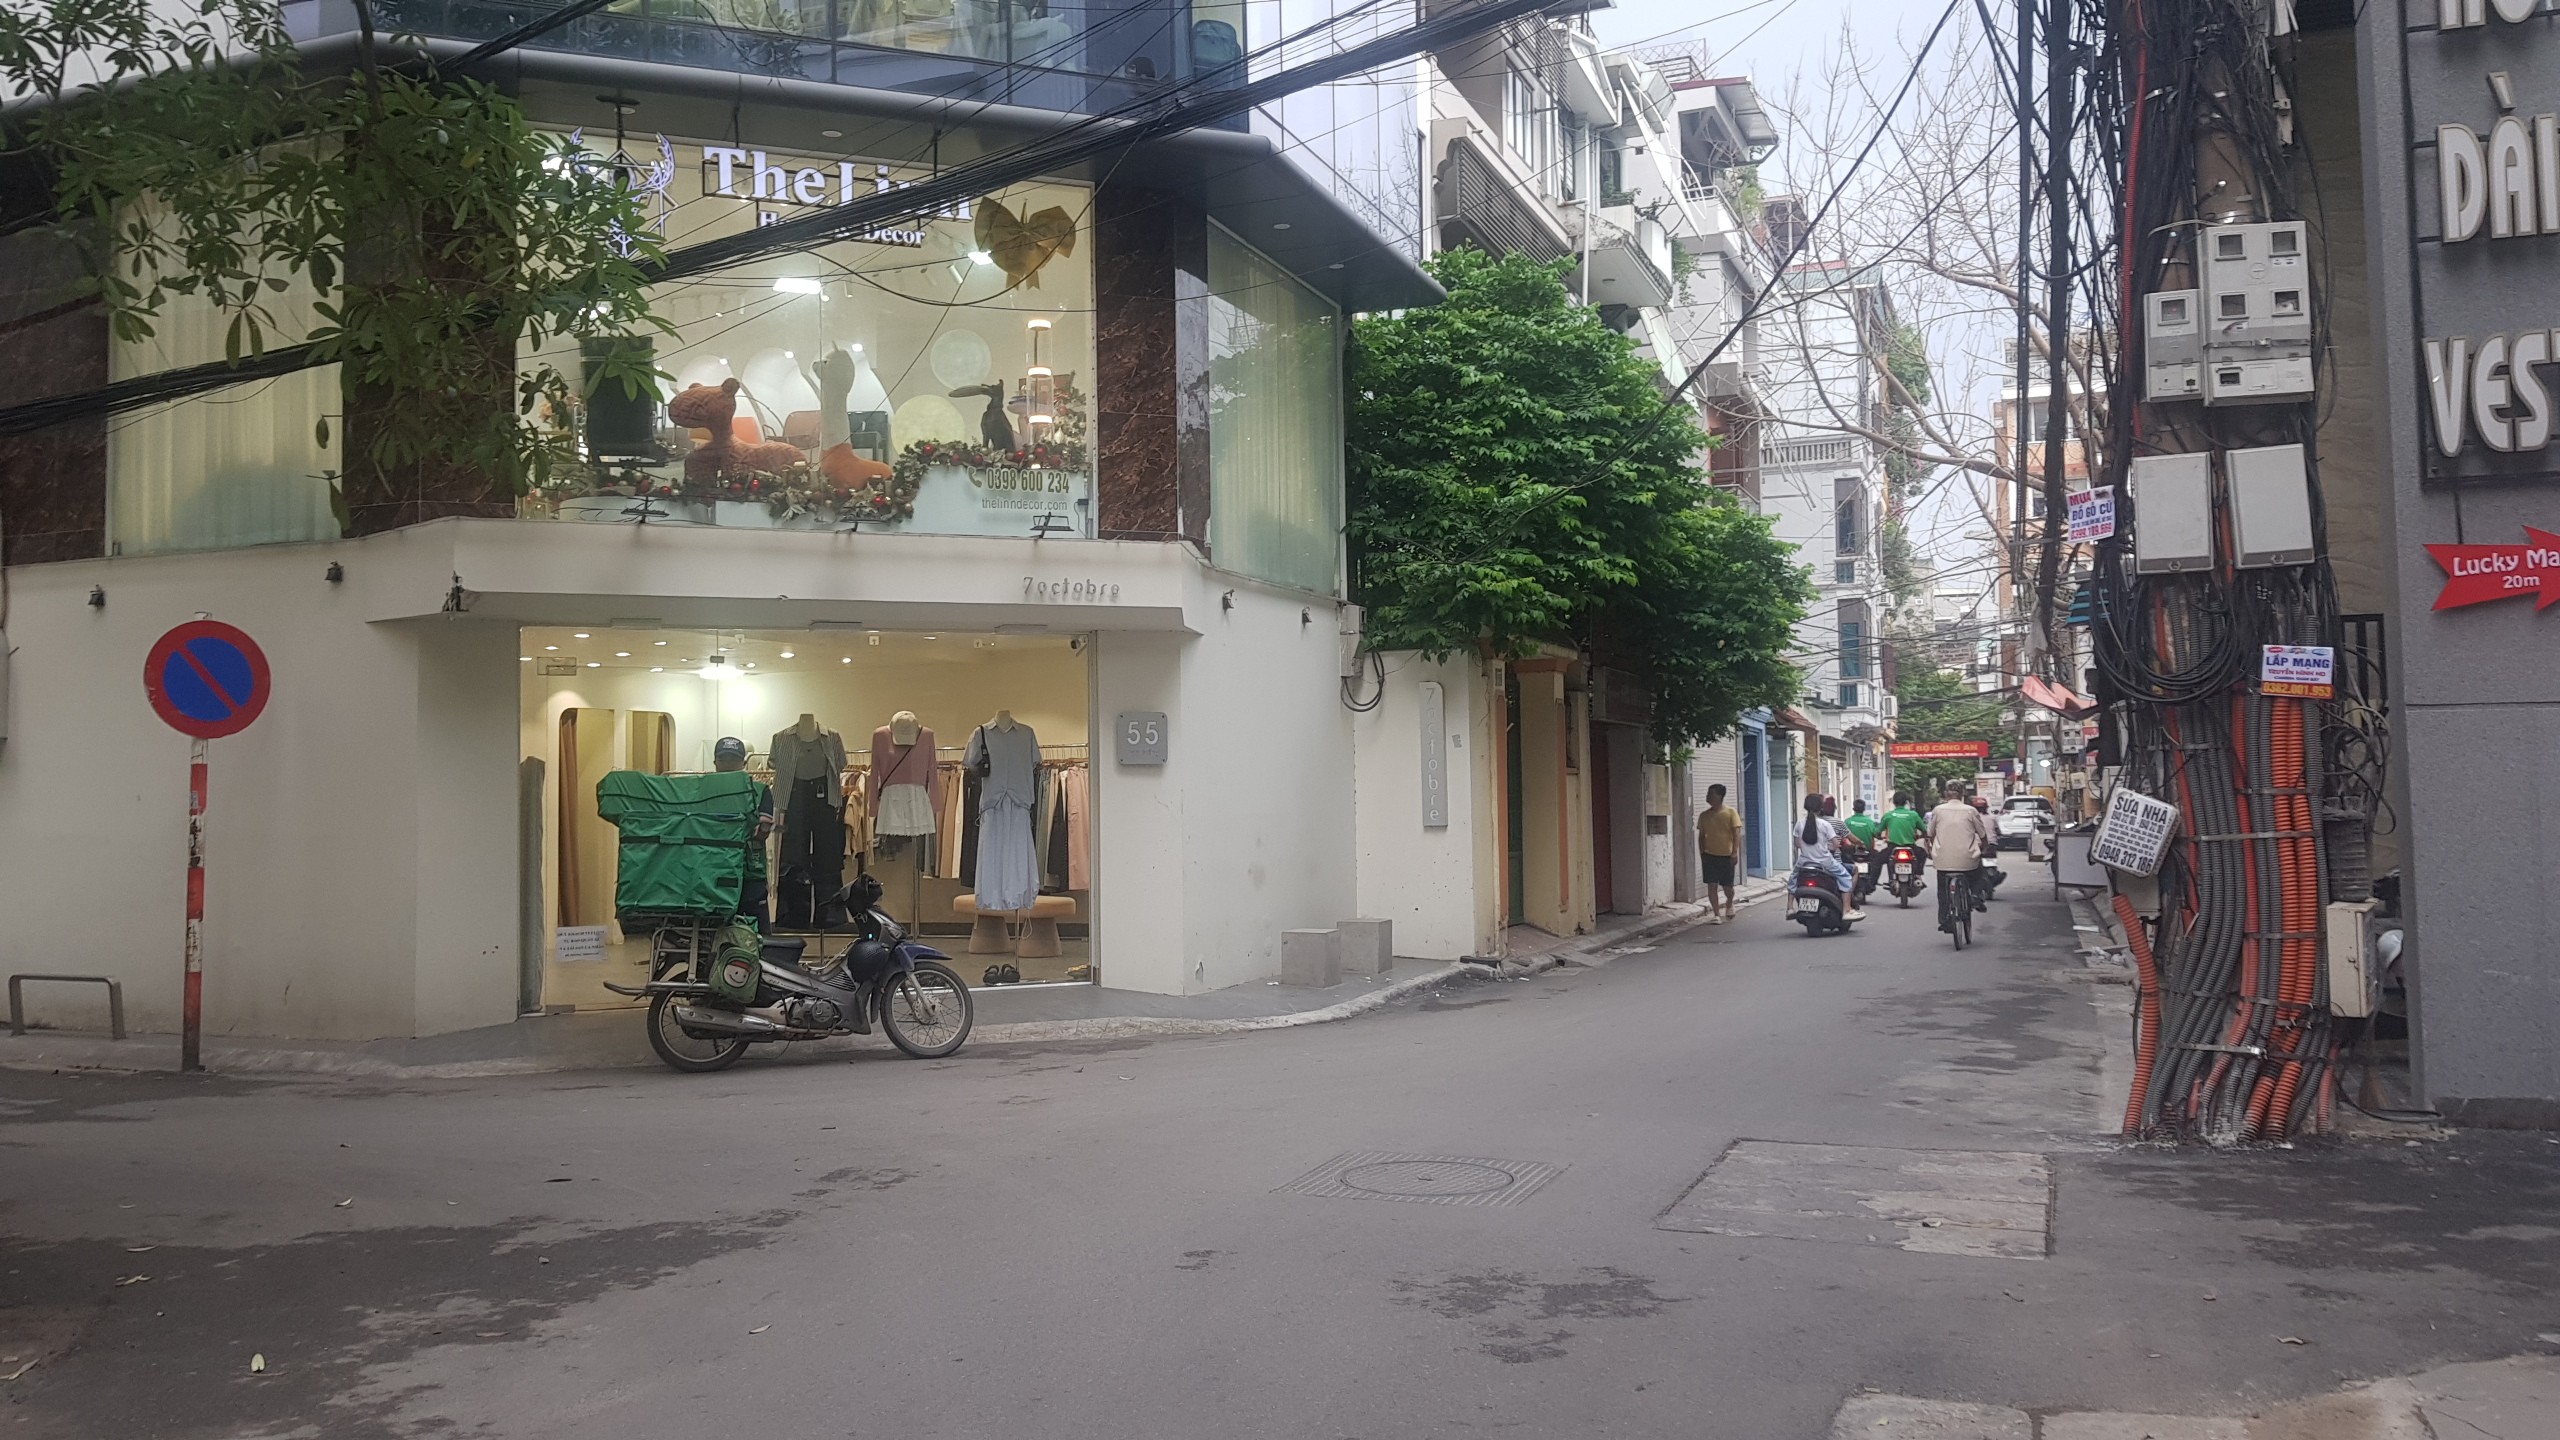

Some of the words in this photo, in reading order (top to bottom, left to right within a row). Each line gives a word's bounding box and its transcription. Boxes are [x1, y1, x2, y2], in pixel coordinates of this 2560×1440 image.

[2436, 72, 2560, 244] DÀI
[703, 146, 827, 206] The
[986, 468, 1017, 490] 0398
[1021, 470, 1043, 492] 600
[1048, 472, 1070, 494] 234
[982, 498, 1068, 511] thelinndecor.com
[2453, 552, 2519, 577] Lucky
[1023, 577, 1120, 596] 7octobre
[2503, 575, 2540, 589] 20m
[2293, 658, 2330, 670] MẠNG
[1127, 721, 1159, 745] 55
[2114, 793, 2139, 816] SỬA
[2142, 804, 2168, 825] NHÀ
